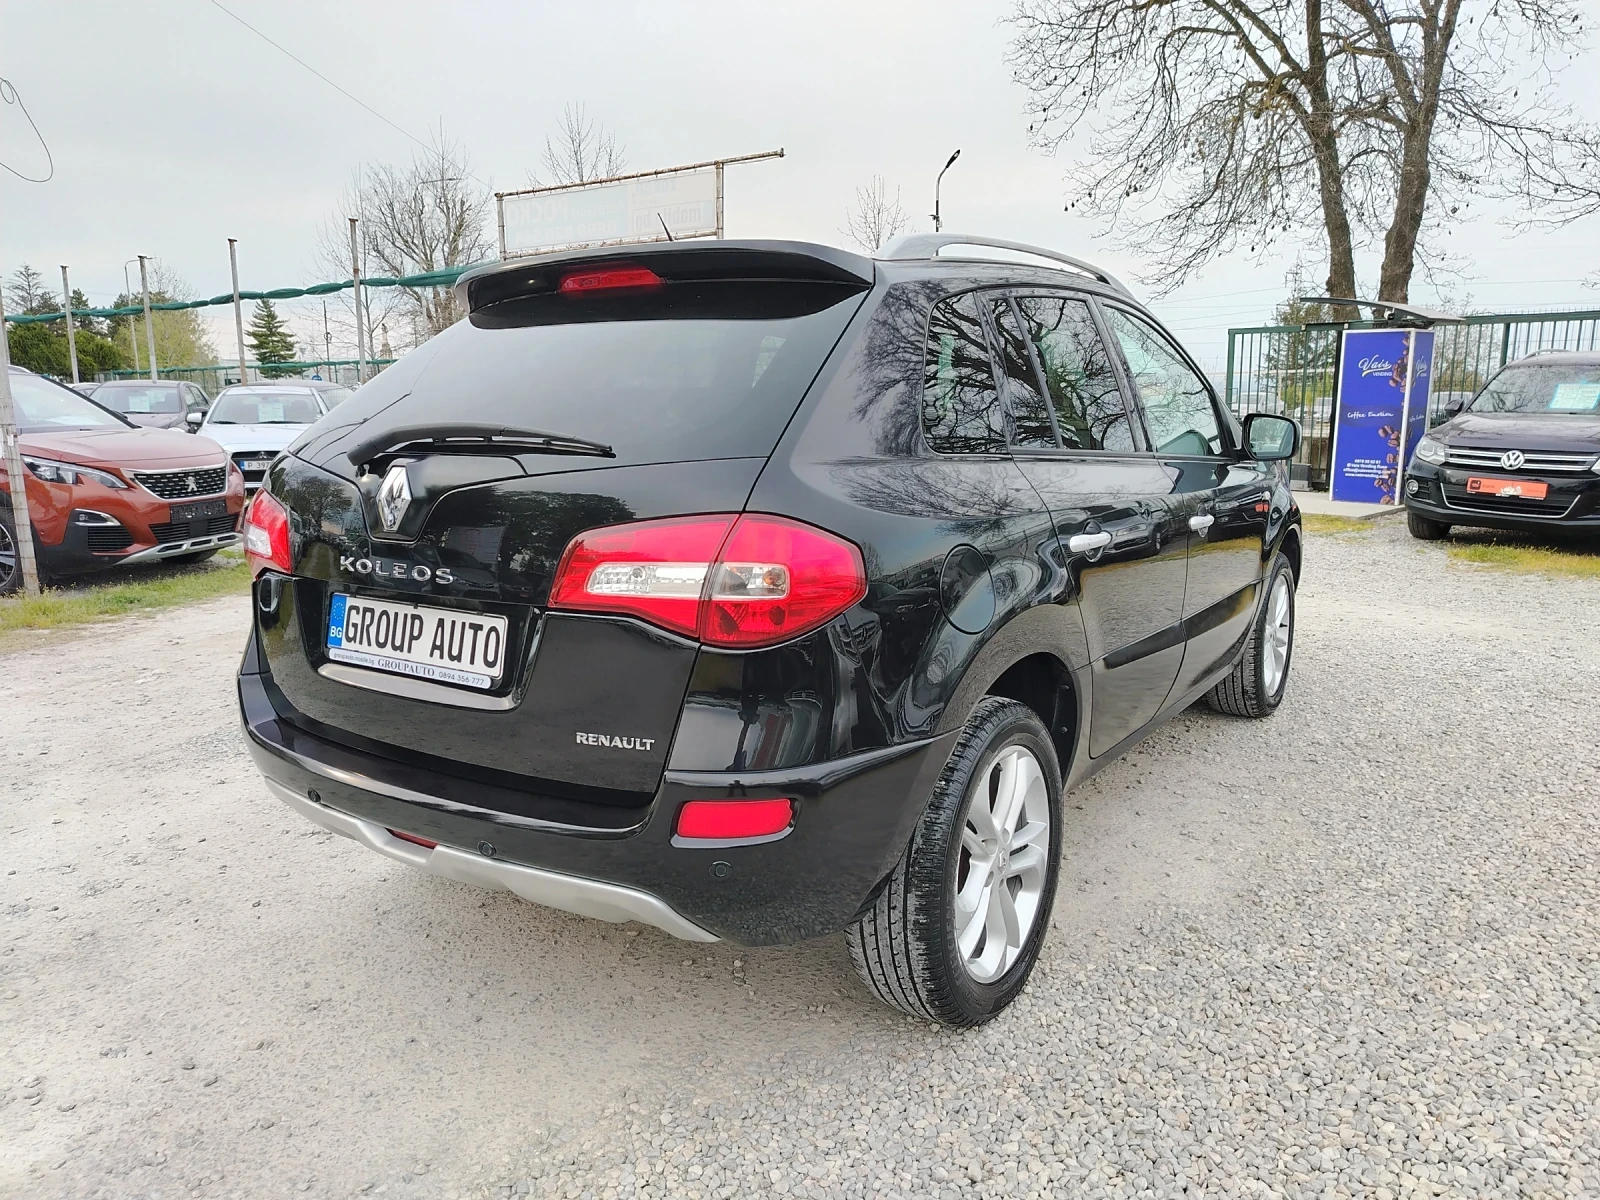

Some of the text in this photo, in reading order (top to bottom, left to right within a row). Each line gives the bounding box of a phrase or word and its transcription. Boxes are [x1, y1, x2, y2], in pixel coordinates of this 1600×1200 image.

[1358, 354, 1392, 371] Vais
[1347, 411, 1366, 419] Coffee
[340, 556, 453, 584] KOLEOS
[330, 626, 342, 638] BG
[344, 605, 500, 668] GROUP AUTO
[333, 652, 485, 686] groupauto.mobile.bg GROUPAUTO 0894 356 777
[576, 732, 655, 751] RENAULT
